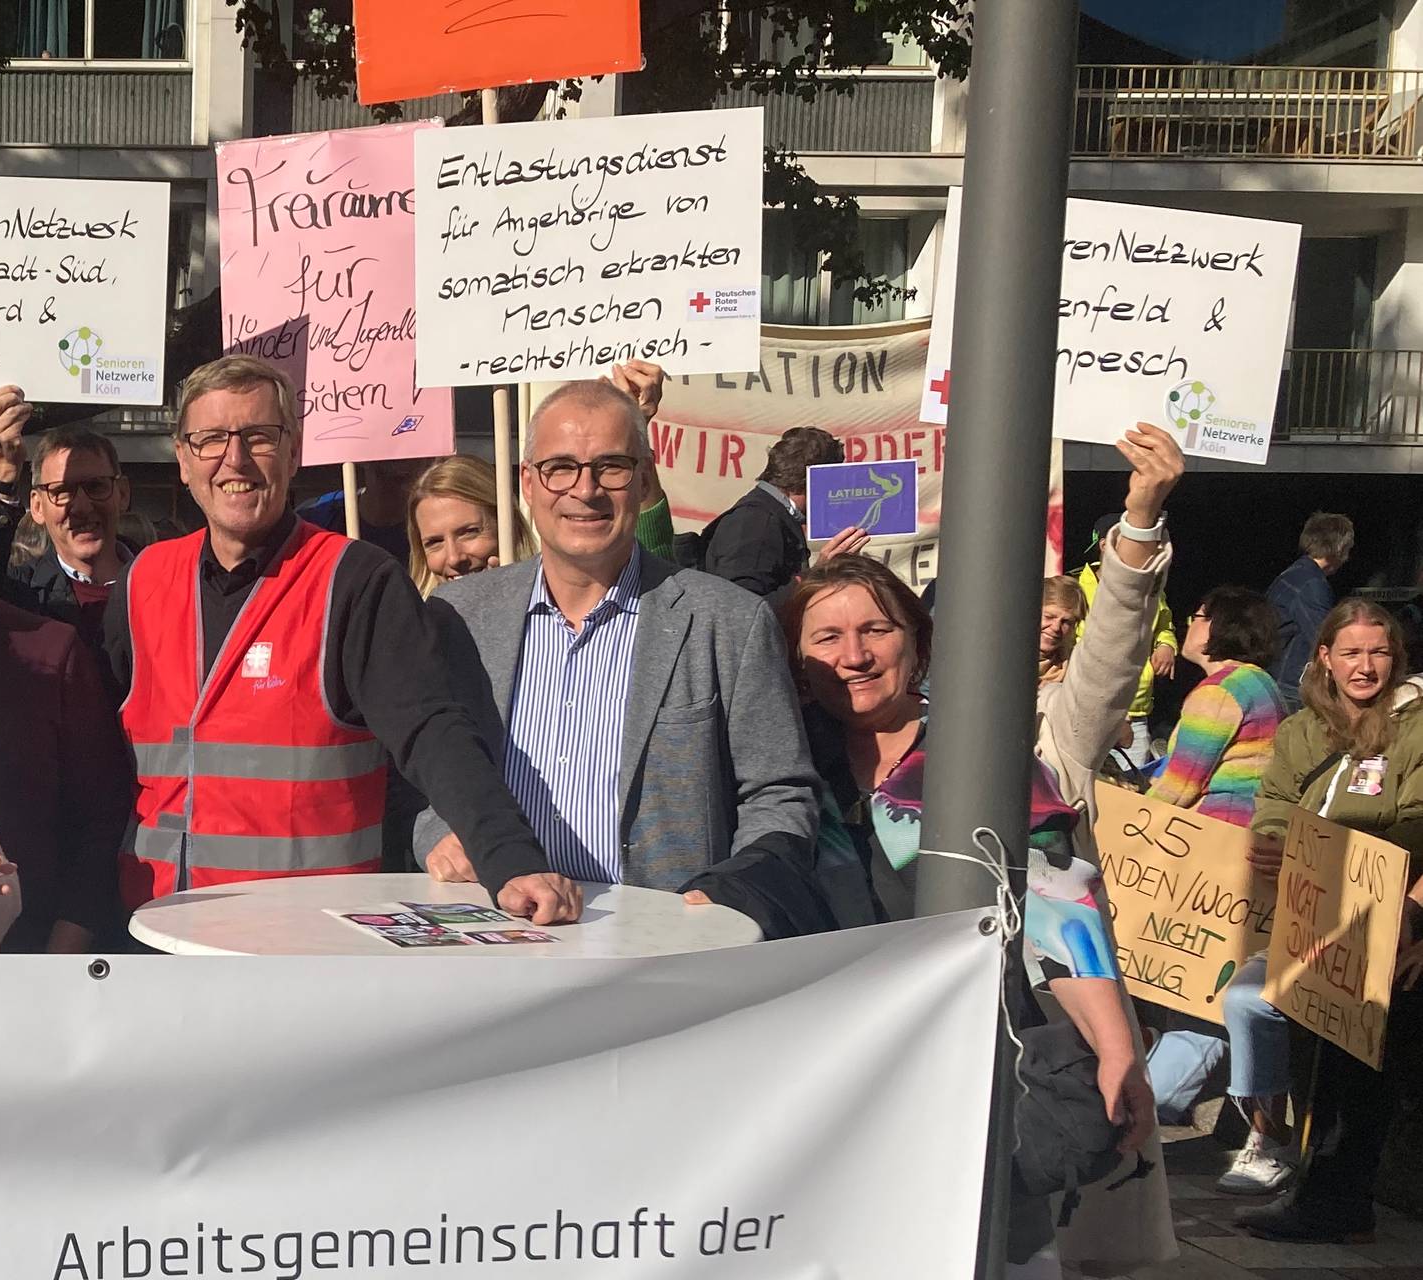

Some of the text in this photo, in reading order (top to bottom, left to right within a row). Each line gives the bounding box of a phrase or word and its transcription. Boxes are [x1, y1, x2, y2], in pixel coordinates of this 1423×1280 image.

[437, 134, 727, 211] Entlastungsdienst
[440, 194, 708, 256] für Angehörige von
[439, 240, 741, 300] somatisch erkrankten
[1063, 229, 1264, 277] renNetzwerk
[283, 245, 380, 320] für
[715, 289, 757, 298] Deutsches
[38, 296, 57, 324] &
[503, 294, 662, 333] Menschen
[1057, 285, 1226, 332] enfeld &
[95, 357, 145, 370] Senioren
[95, 370, 155, 382] Netzwerke
[95, 382, 121, 395] Köln
[1202, 426, 1265, 446] Netzwerke
[1204, 412, 1257, 431] Senioren
[650, 421, 746, 478] WIR
[1200, 437, 1226, 455] Köln
[828, 487, 880, 498] LATIBUL
[1123, 808, 1203, 858] 25
[1348, 844, 1387, 903] UNS
[1286, 872, 1327, 927] NICHT
[1141, 912, 1227, 955] NICHT
[1286, 921, 1369, 1002] DUNKELN
[53, 1206, 785, 1280] Arbeitsgemeinschaft der
